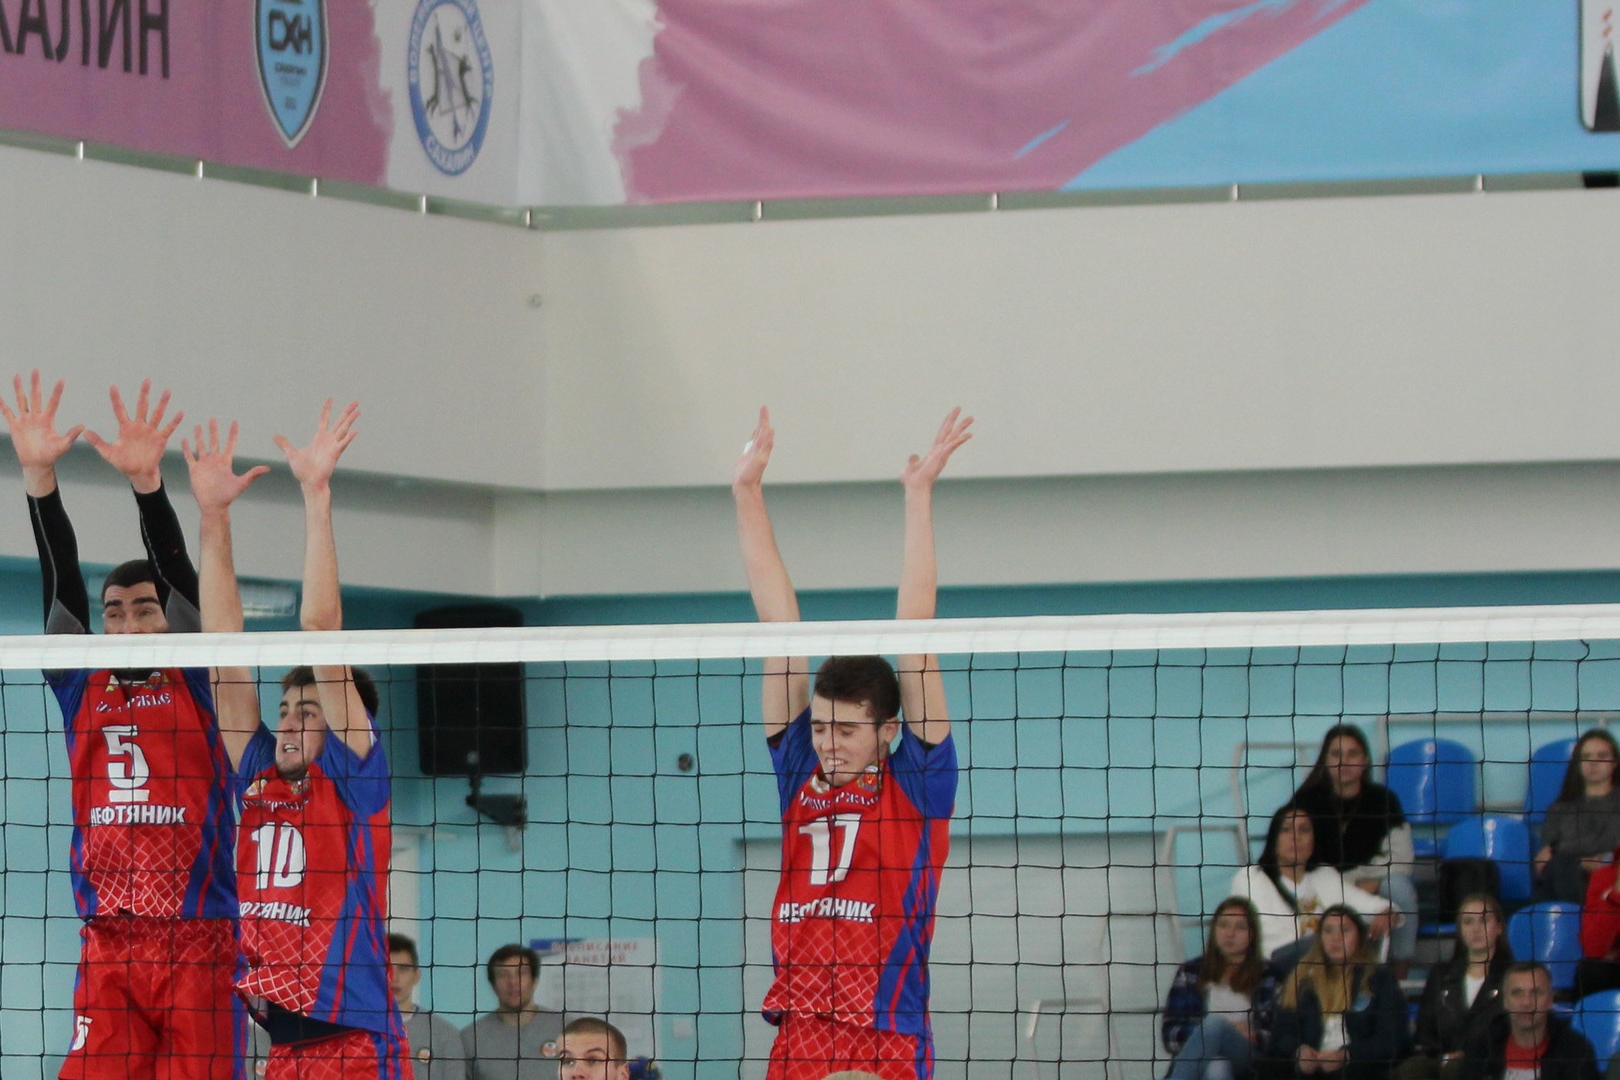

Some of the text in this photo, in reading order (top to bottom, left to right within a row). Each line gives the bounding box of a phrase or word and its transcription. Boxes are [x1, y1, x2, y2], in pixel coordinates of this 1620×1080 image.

[101, 725, 150, 789] 5
[90, 804, 186, 827] НЕФТЯНИК
[251, 821, 307, 890] 10
[798, 813, 862, 886] 17
[239, 901, 311, 927] ФТЯНИК
[72, 1015, 93, 1051] 5
